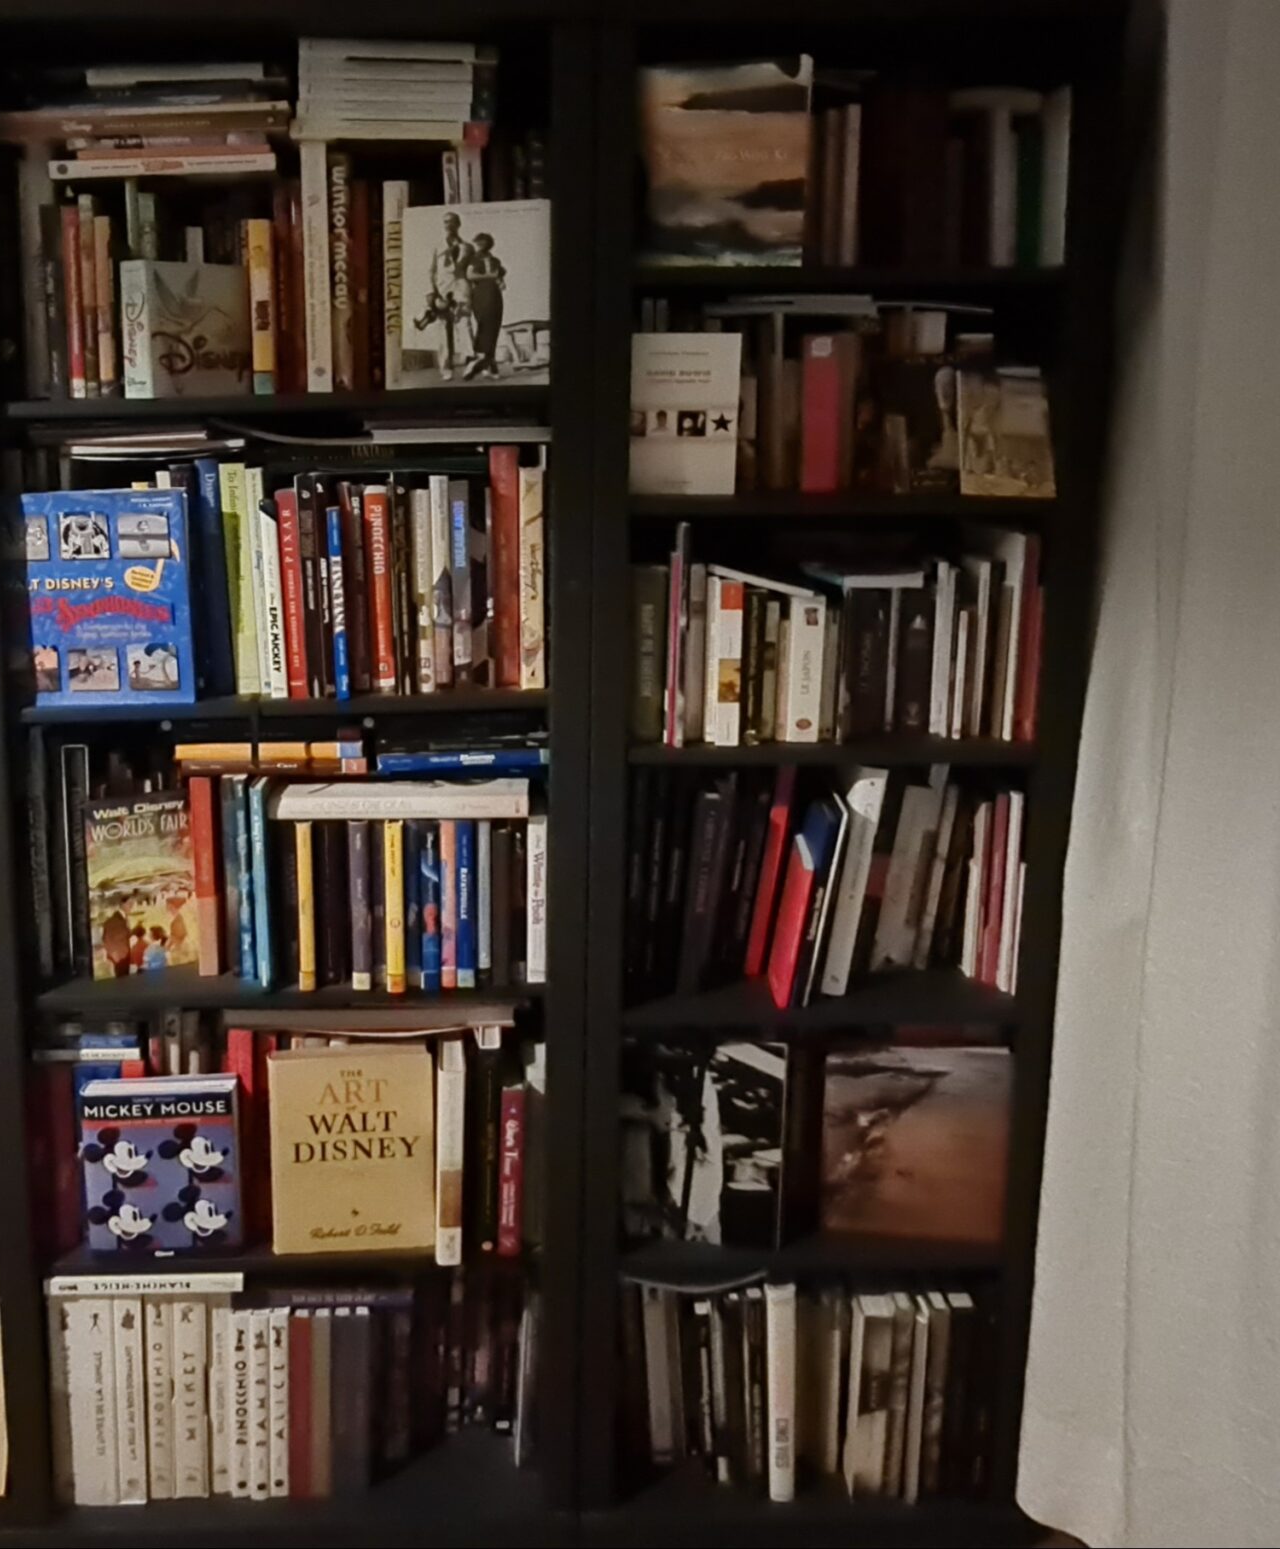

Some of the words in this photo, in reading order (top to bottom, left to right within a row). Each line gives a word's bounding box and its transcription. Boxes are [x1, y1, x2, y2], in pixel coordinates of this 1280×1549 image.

[331, 166, 347, 237] winsor
[334, 238, 349, 309] mccay
[124, 291, 145, 368] Disney
[370, 504, 385, 575] PINOCCHIO
[45, 577, 114, 590] DISNEY'S
[330, 556, 345, 633] DISNEYANA
[268, 606, 279, 633] EPIC
[270, 632, 282, 673] MICKEY
[93, 808, 129, 820] Walt
[134, 800, 184, 812] Disney
[160, 813, 188, 832] FAIR
[531, 898, 544, 924] Pooh
[340, 1069, 363, 1078] THE
[83, 1103, 155, 1118] MICKEY
[160, 1100, 226, 1115] MOUSE
[319, 1079, 389, 1105] ART
[307, 1110, 398, 1135] WALT
[292, 1136, 421, 1164] DISNEY
[93, 1282, 191, 1290] BLANCHE-NEIGE
[152, 1342, 164, 1448] PINOCCHIO
[183, 1351, 196, 1440] MICKEY
[234, 1360, 247, 1445] PINOCCHIO
[255, 1362, 267, 1447] BAMBI
[273, 1363, 286, 1440] ALICE
